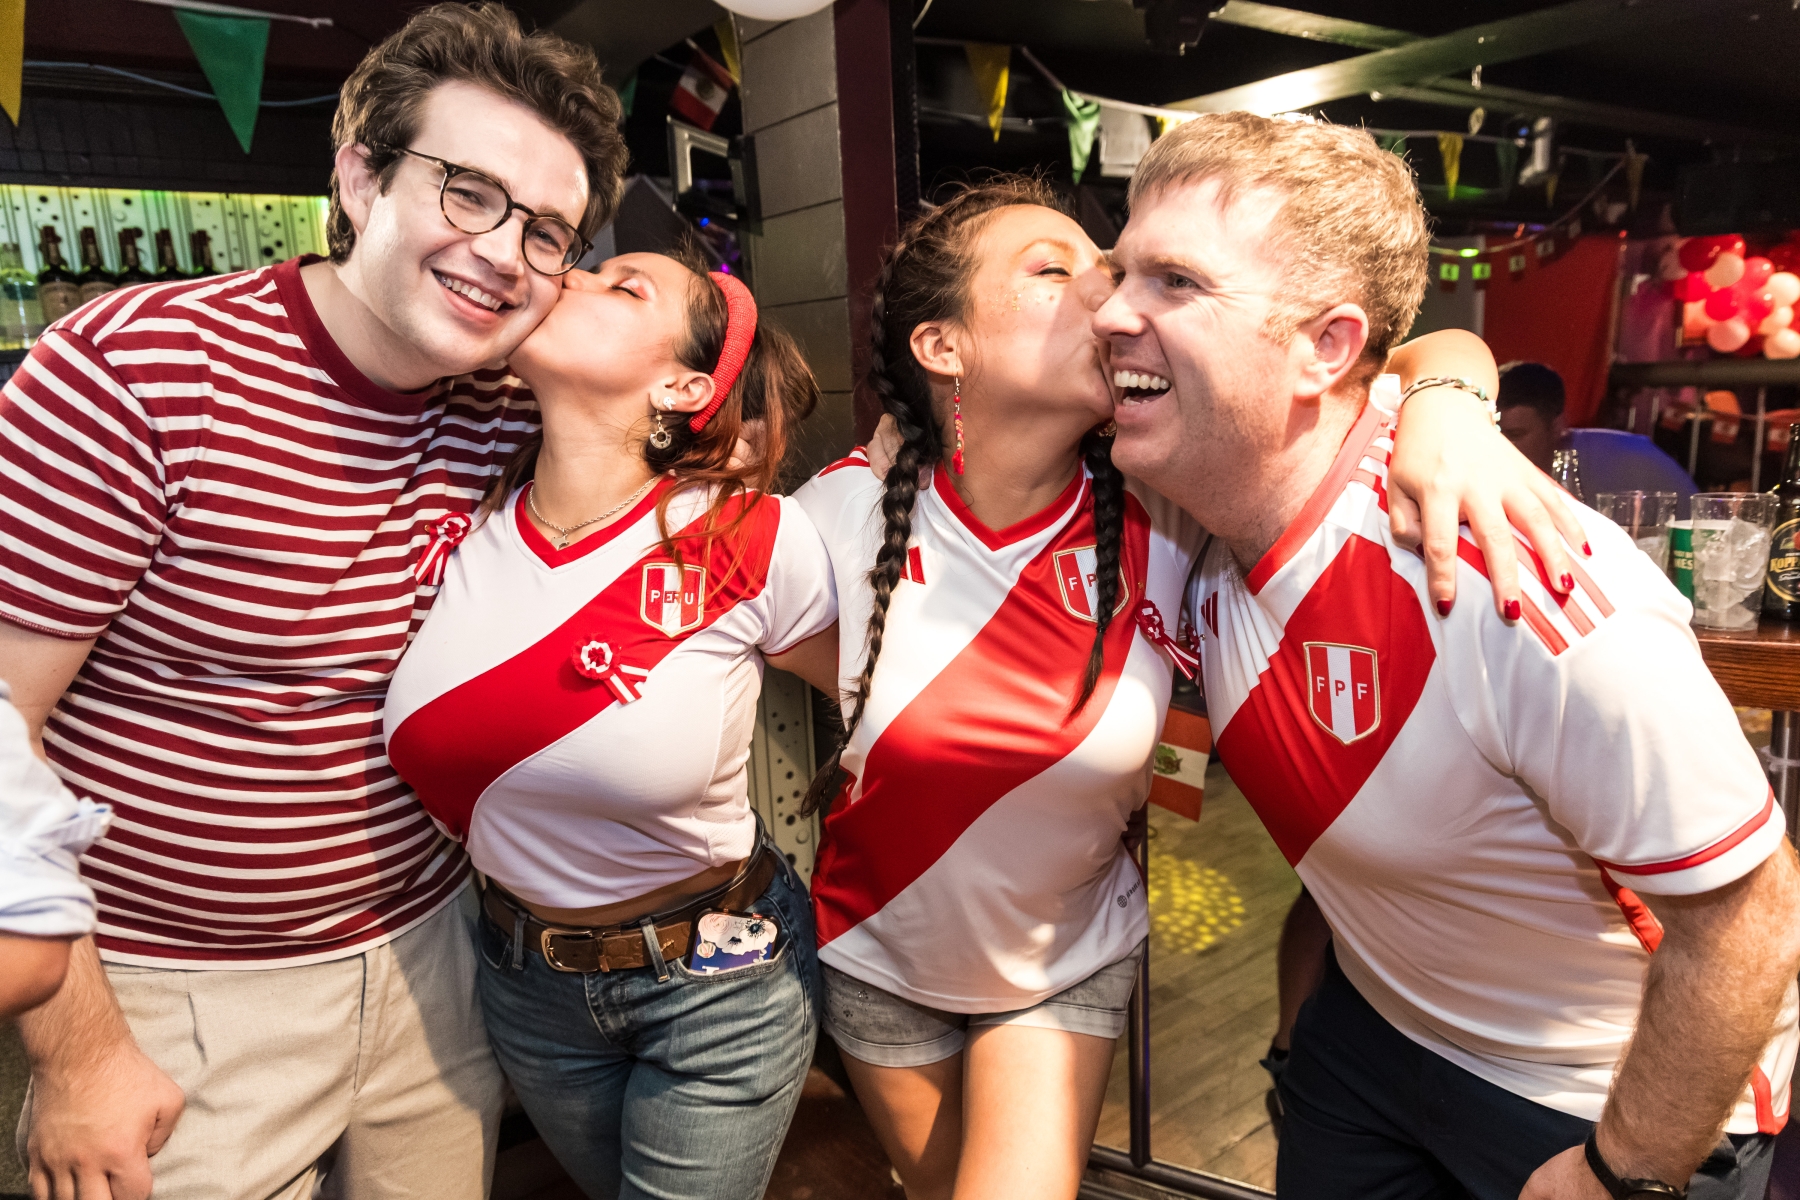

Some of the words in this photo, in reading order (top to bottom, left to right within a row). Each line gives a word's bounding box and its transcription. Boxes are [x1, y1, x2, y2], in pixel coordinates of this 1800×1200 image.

[1770, 556, 1800, 573] KOPP
[1068, 573, 1097, 591] FP
[1316, 675, 1368, 700] FPF
